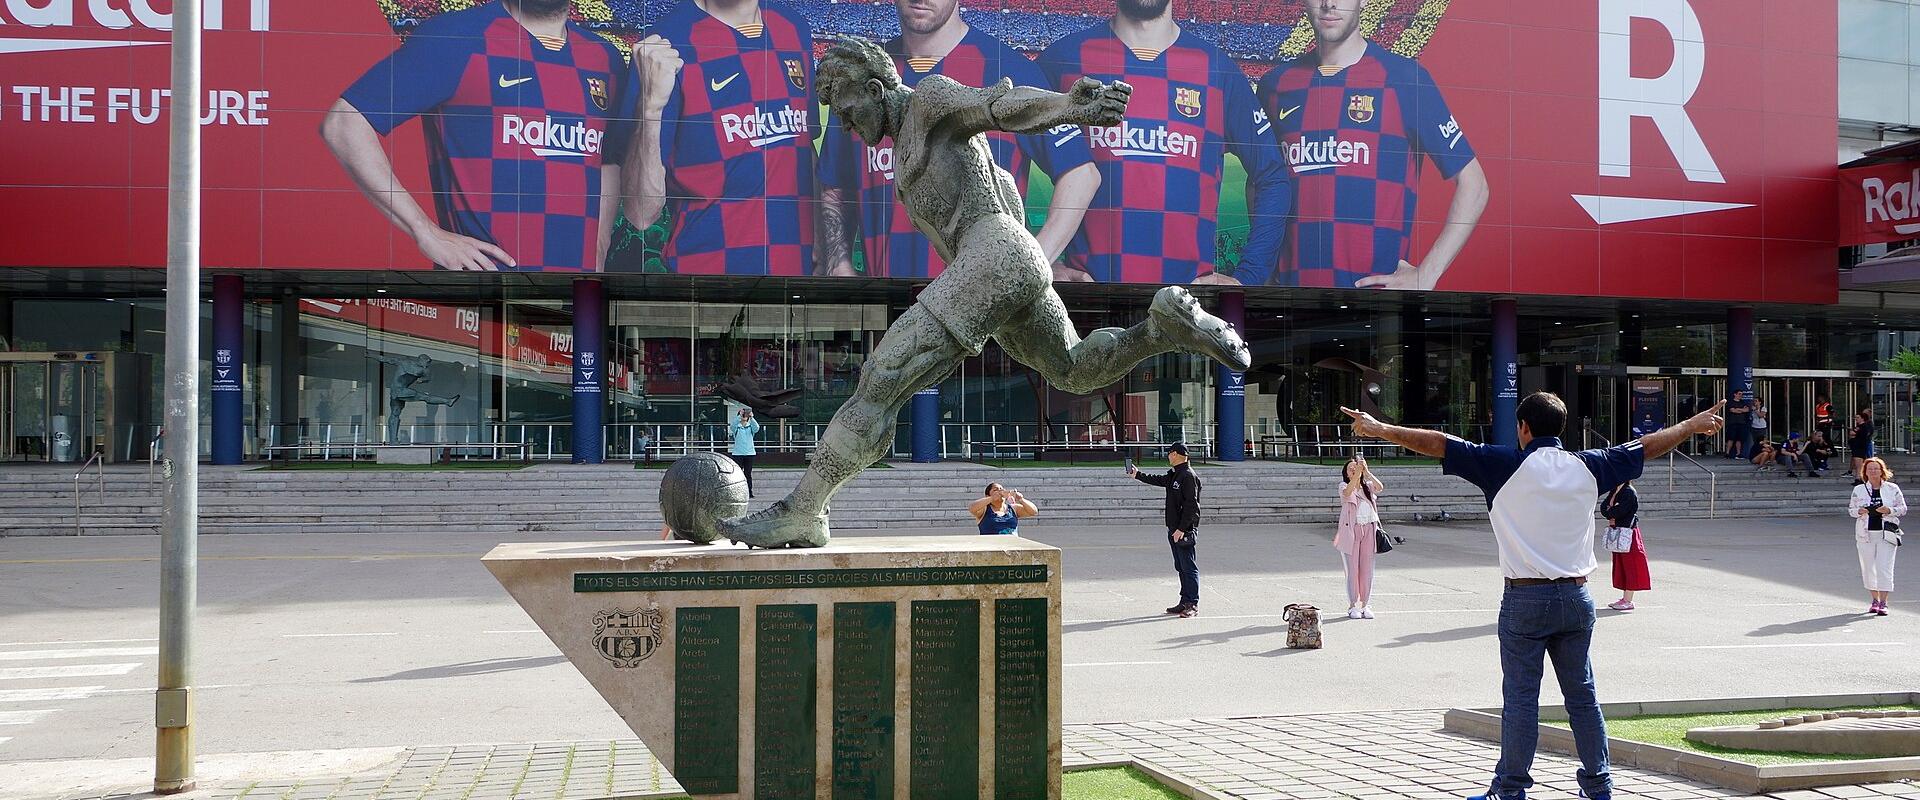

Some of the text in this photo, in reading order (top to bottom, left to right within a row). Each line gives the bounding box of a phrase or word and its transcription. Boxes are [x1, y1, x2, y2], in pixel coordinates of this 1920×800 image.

[12, 85, 95, 122] THE
[108, 87, 269, 126] FUURE
[1599, 0, 1726, 183] R
[1089, 120, 1197, 158] Rakuten
[617, 577, 640, 587] ELS
[681, 576, 705, 586] HAN
[709, 575, 744, 586] ESTAT
[750, 574, 815, 585] POSSIBLES
[872, 572, 893, 583] ALS
[896, 571, 929, 582] MEUS
[931, 571, 995, 582] COMPANYS
